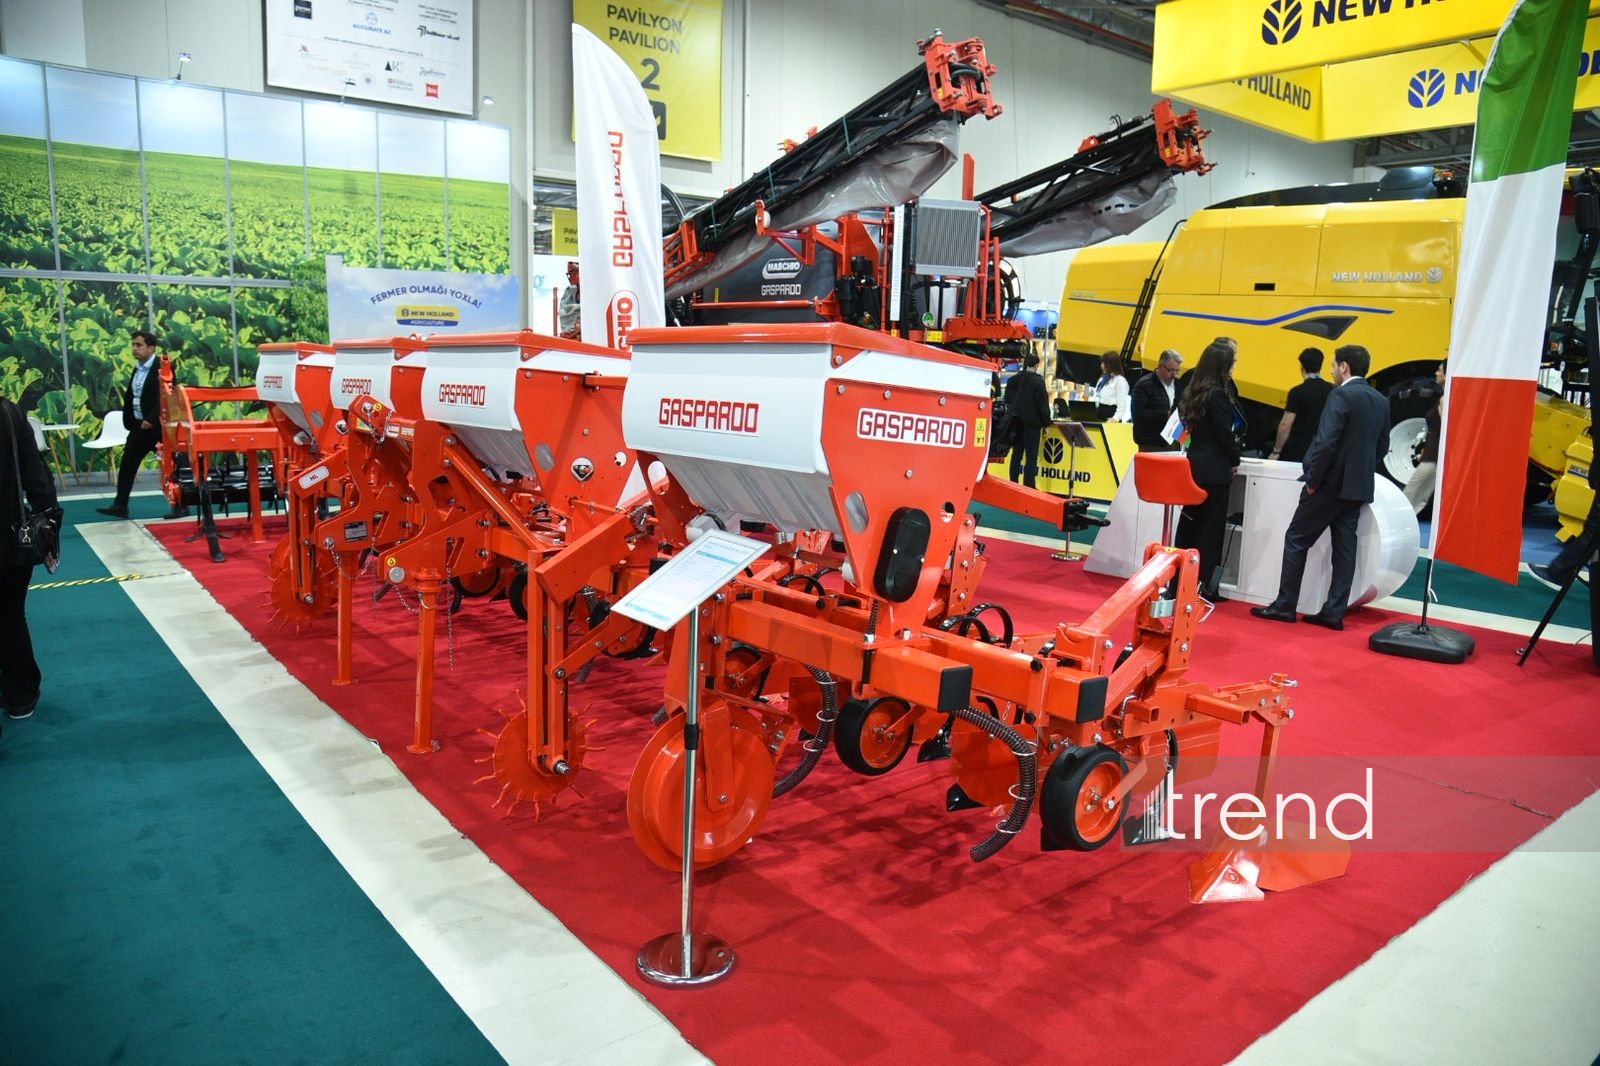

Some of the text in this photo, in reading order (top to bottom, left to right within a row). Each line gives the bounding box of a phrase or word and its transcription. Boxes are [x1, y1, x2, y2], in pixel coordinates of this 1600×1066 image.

[607, 4, 682, 33] PAVİLYON
[609, 27, 681, 55] PAVILION
[640, 58, 660, 91] 2
[767, 261, 800, 272] MASCHIO
[1331, 271, 1424, 283] NEW HOLLAND
[370, 287, 407, 305] FERMER
[449, 289, 482, 309] YOXLA!
[761, 284, 801, 296] GASPARDO
[439, 383, 486, 406] GASPARDO
[658, 397, 758, 433] GASPARDO
[858, 409, 964, 446] GASPARDO
